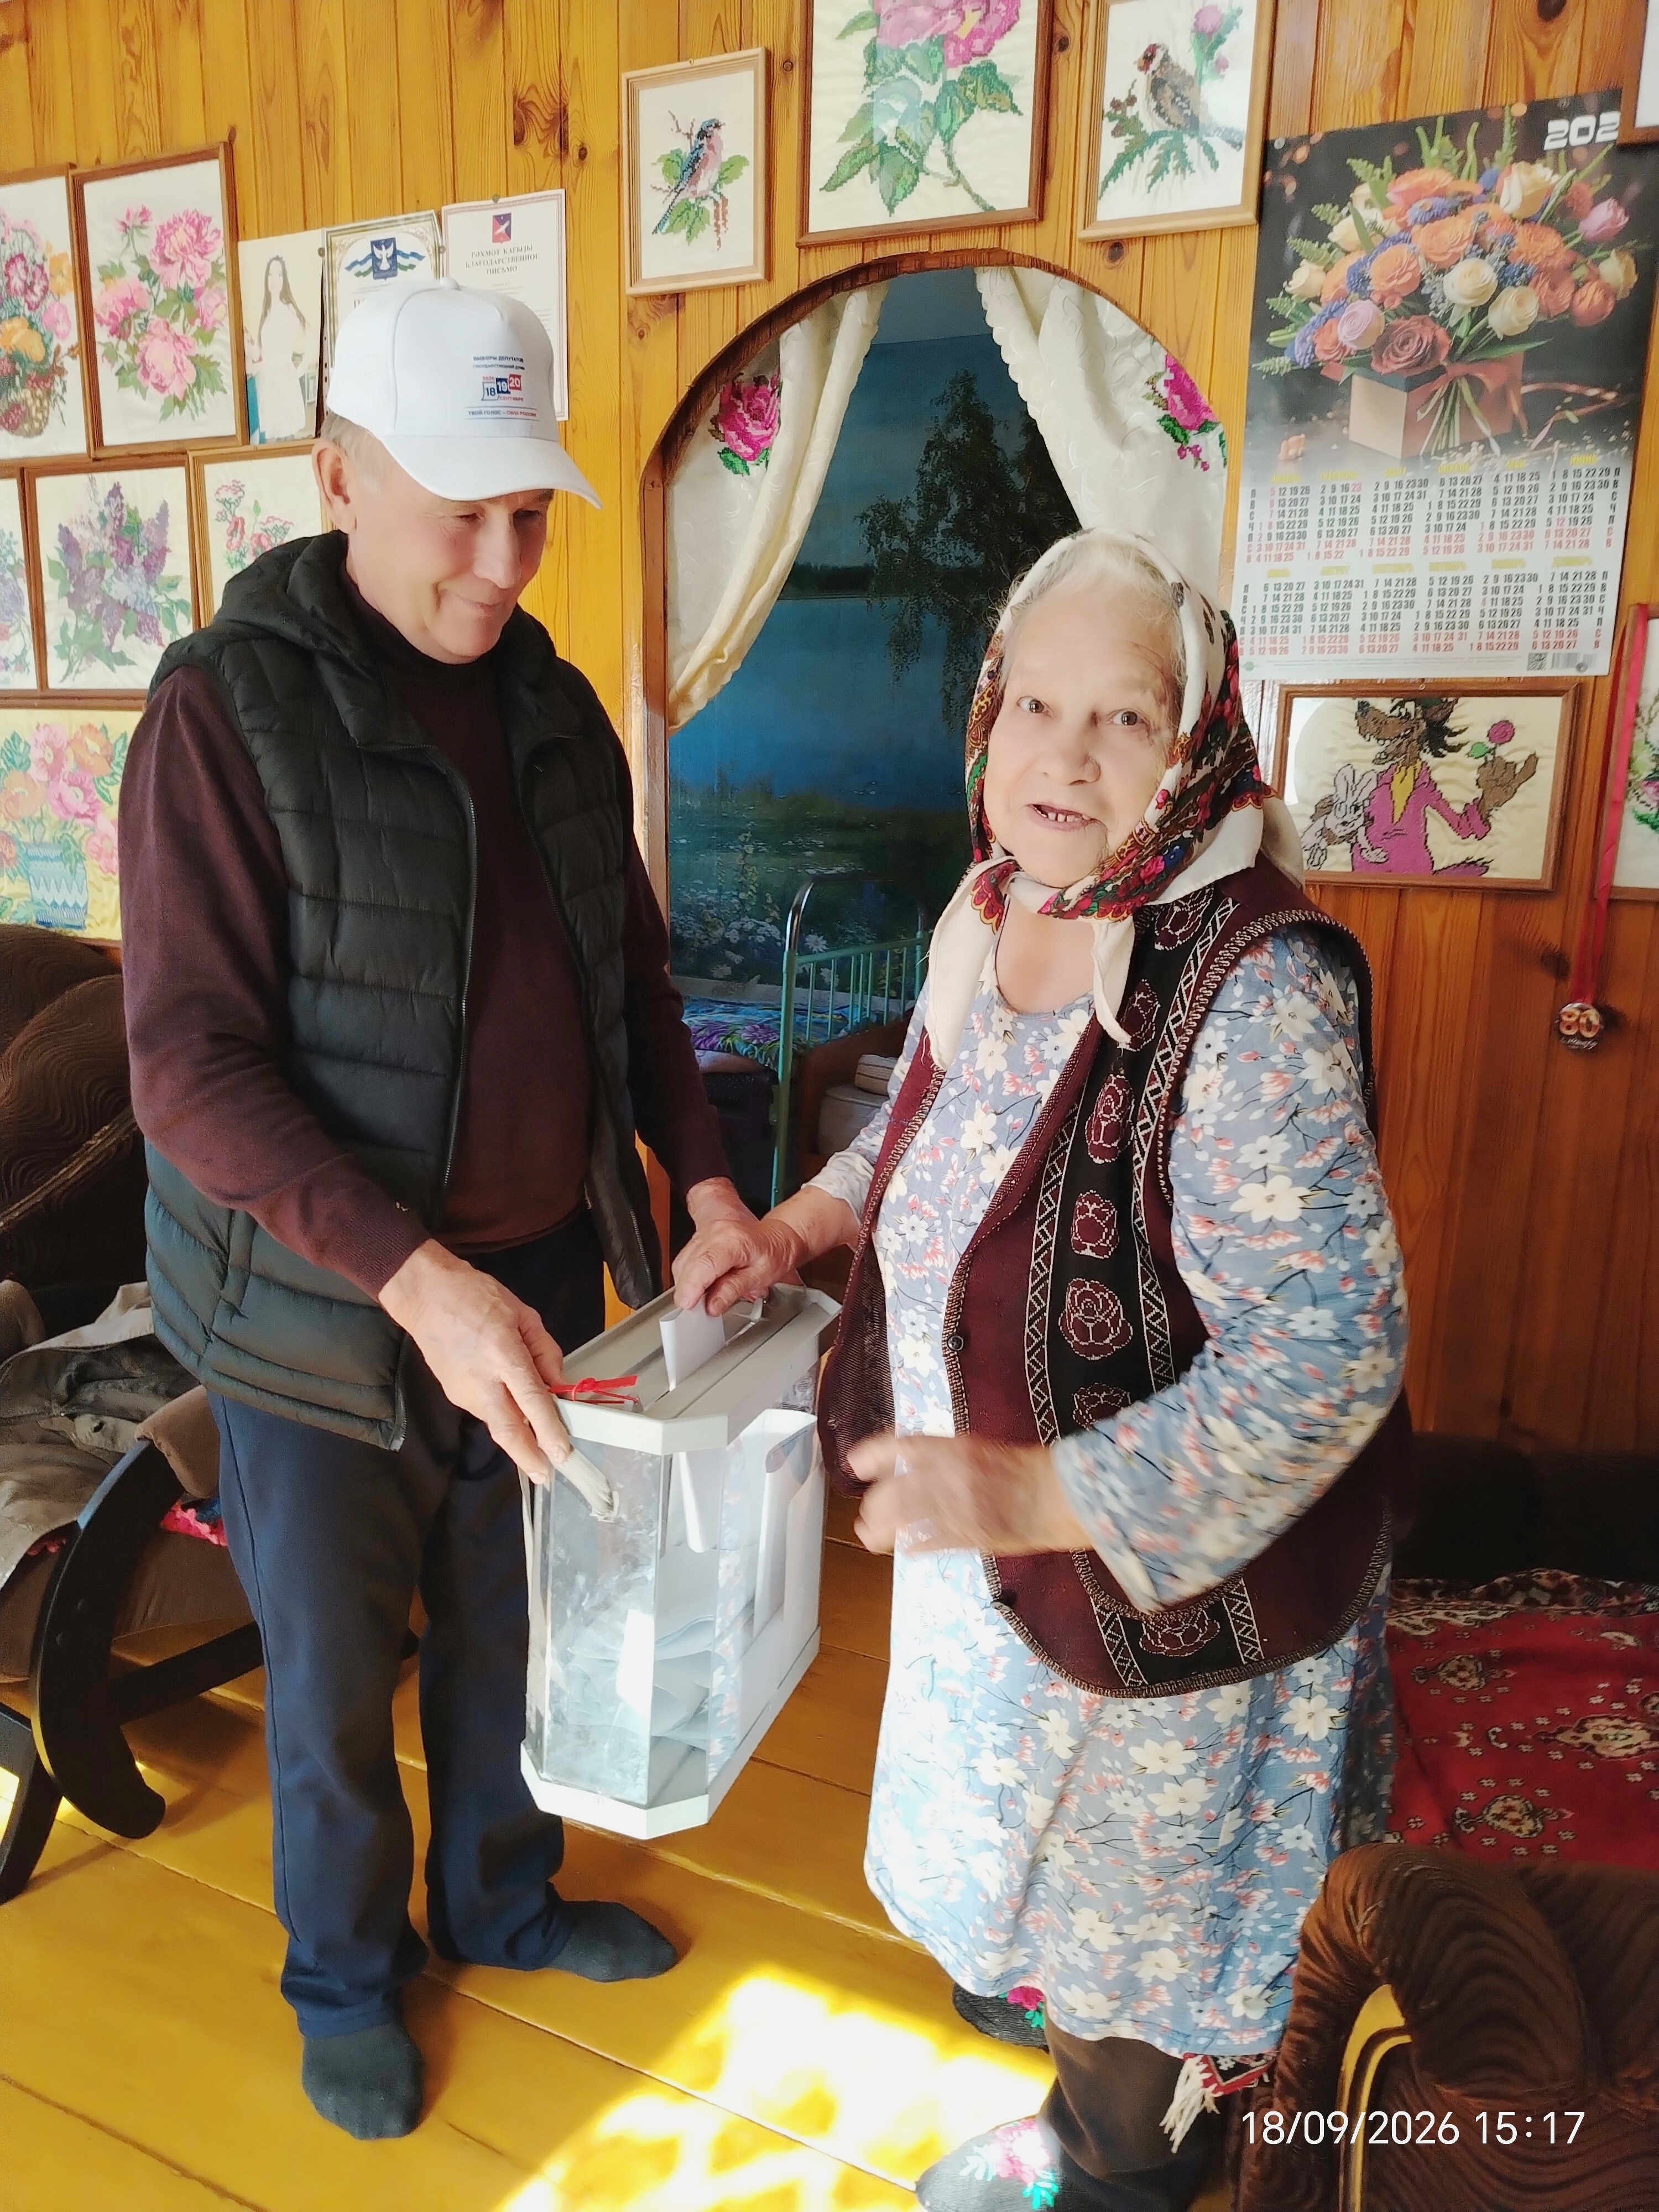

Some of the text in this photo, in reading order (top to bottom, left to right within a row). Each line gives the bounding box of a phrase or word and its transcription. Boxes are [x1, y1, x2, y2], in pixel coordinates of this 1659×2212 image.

[1543, 111, 1621, 151] 202
[465, 253, 540, 268] БЛАГОДАРСТВЕННОЕ
[487, 265, 518, 275] ПИСЬМО
[485, 377, 521, 397] 18 19 20
[1279, 486, 1287, 496] 12
[1405, 479, 1416, 489] 23
[1473, 474, 1482, 484] 27
[1505, 473, 1513, 483] 11
[1528, 471, 1540, 481] 25
[1573, 468, 1582, 478] 15
[1585, 468, 1596, 477] 22
[1299, 497, 1309, 507] 27
[1340, 494, 1348, 504] 17
[1350, 494, 1360, 504] 24
[1394, 491, 1401, 501] 17
[1404, 491, 1415, 500] 24
[1416, 490, 1426, 499] 31
[1448, 488, 1456, 498] 14
[1459, 487, 1468, 497] 21
[1504, 485, 1512, 494] 12
[1584, 480, 1595, 489] 23
[1277, 509, 1285, 518] 14
[1287, 508, 1297, 518] 21
[1328, 506, 1336, 516] 11
[1349, 505, 1359, 515] 25
[1381, 503, 1389, 513] 11
[1403, 502, 1413, 512] 25
[1447, 499, 1456, 509] 15
[1458, 499, 1468, 509] 22
[1526, 494, 1538, 505] 27
[1571, 492, 1580, 502] 17
[1583, 492, 1594, 501] 24
[1276, 520, 1285, 530] 15
[1286, 519, 1296, 529] 22
[1327, 518, 1335, 527] 12
[1379, 514, 1388, 524] 12
[1457, 510, 1468, 520] 23
[1501, 508, 1510, 518] 14
[1512, 507, 1523, 517] 21
[1557, 504, 1566, 515] 11
[1582, 504, 1593, 513] 25
[1285, 530, 1295, 540] 23
[1347, 527, 1358, 537] 27
[1401, 524, 1411, 534] 27
[1445, 522, 1454, 532] 17
[1455, 522, 1466, 531] 24
[1500, 519, 1509, 529] 15
[1511, 519, 1523, 529] 22
[1296, 581, 1305, 591] 27
[1333, 580, 1342, 589] 17
[1343, 579, 1353, 588] 24
[1354, 579, 1364, 588] 31
[1384, 578, 1392, 587] 14
[1395, 577, 1404, 587] 21
[1438, 576, 1447, 585] 12
[1514, 573, 1526, 583] 23
[1560, 571, 1568, 581] 14
[1572, 571, 1582, 581] 21
[1272, 593, 1280, 602] 14
[1283, 592, 1292, 602] 21
[1321, 591, 1329, 601] 11
[1342, 590, 1352, 599] 25
[1383, 588, 1391, 598] 15
[1393, 588, 1404, 598] 22
[1462, 586, 1472, 596] 27
[1503, 585, 1511, 594] 17
[1513, 585, 1524, 594] 24
[1559, 583, 1568, 593] 15
[1571, 583, 1582, 592] 22
[1271, 603, 1280, 613] 15
[1281, 603, 1291, 613] 22
[1320, 602, 1328, 612] 12
[1392, 599, 1402, 609] 23
[1436, 599, 1444, 608] 14
[1447, 598, 1457, 608] 21
[1490, 597, 1498, 607] 11
[1511, 596, 1523, 606] 25
[1570, 594, 1581, 604] 23
[1280, 614, 1291, 623] 23
[1340, 612, 1350, 622] 27
[1381, 611, 1389, 620] 17
[1391, 611, 1401, 620] 24
[1435, 609, 1444, 619] 15
[1446, 609, 1457, 619] 22
[1489, 608, 1497, 618] 12
[1557, 606, 1566, 616] 17
[1568, 606, 1579, 615] 24
[1582, 606, 1593, 615] 31
[1270, 625, 1277, 634] 17
[1280, 625, 1289, 634] 24
[1292, 624, 1301, 634] 31
[1318, 624, 1326, 633] 14
[1328, 623, 1338, 633] 21
[1369, 623, 1377, 632] 11
[1390, 622, 1400, 632] 25
[1444, 620, 1455, 630] 23
[1510, 619, 1520, 628] 27
[1543, 618, 1551, 628] 11
[1567, 618, 1578, 627] 25
